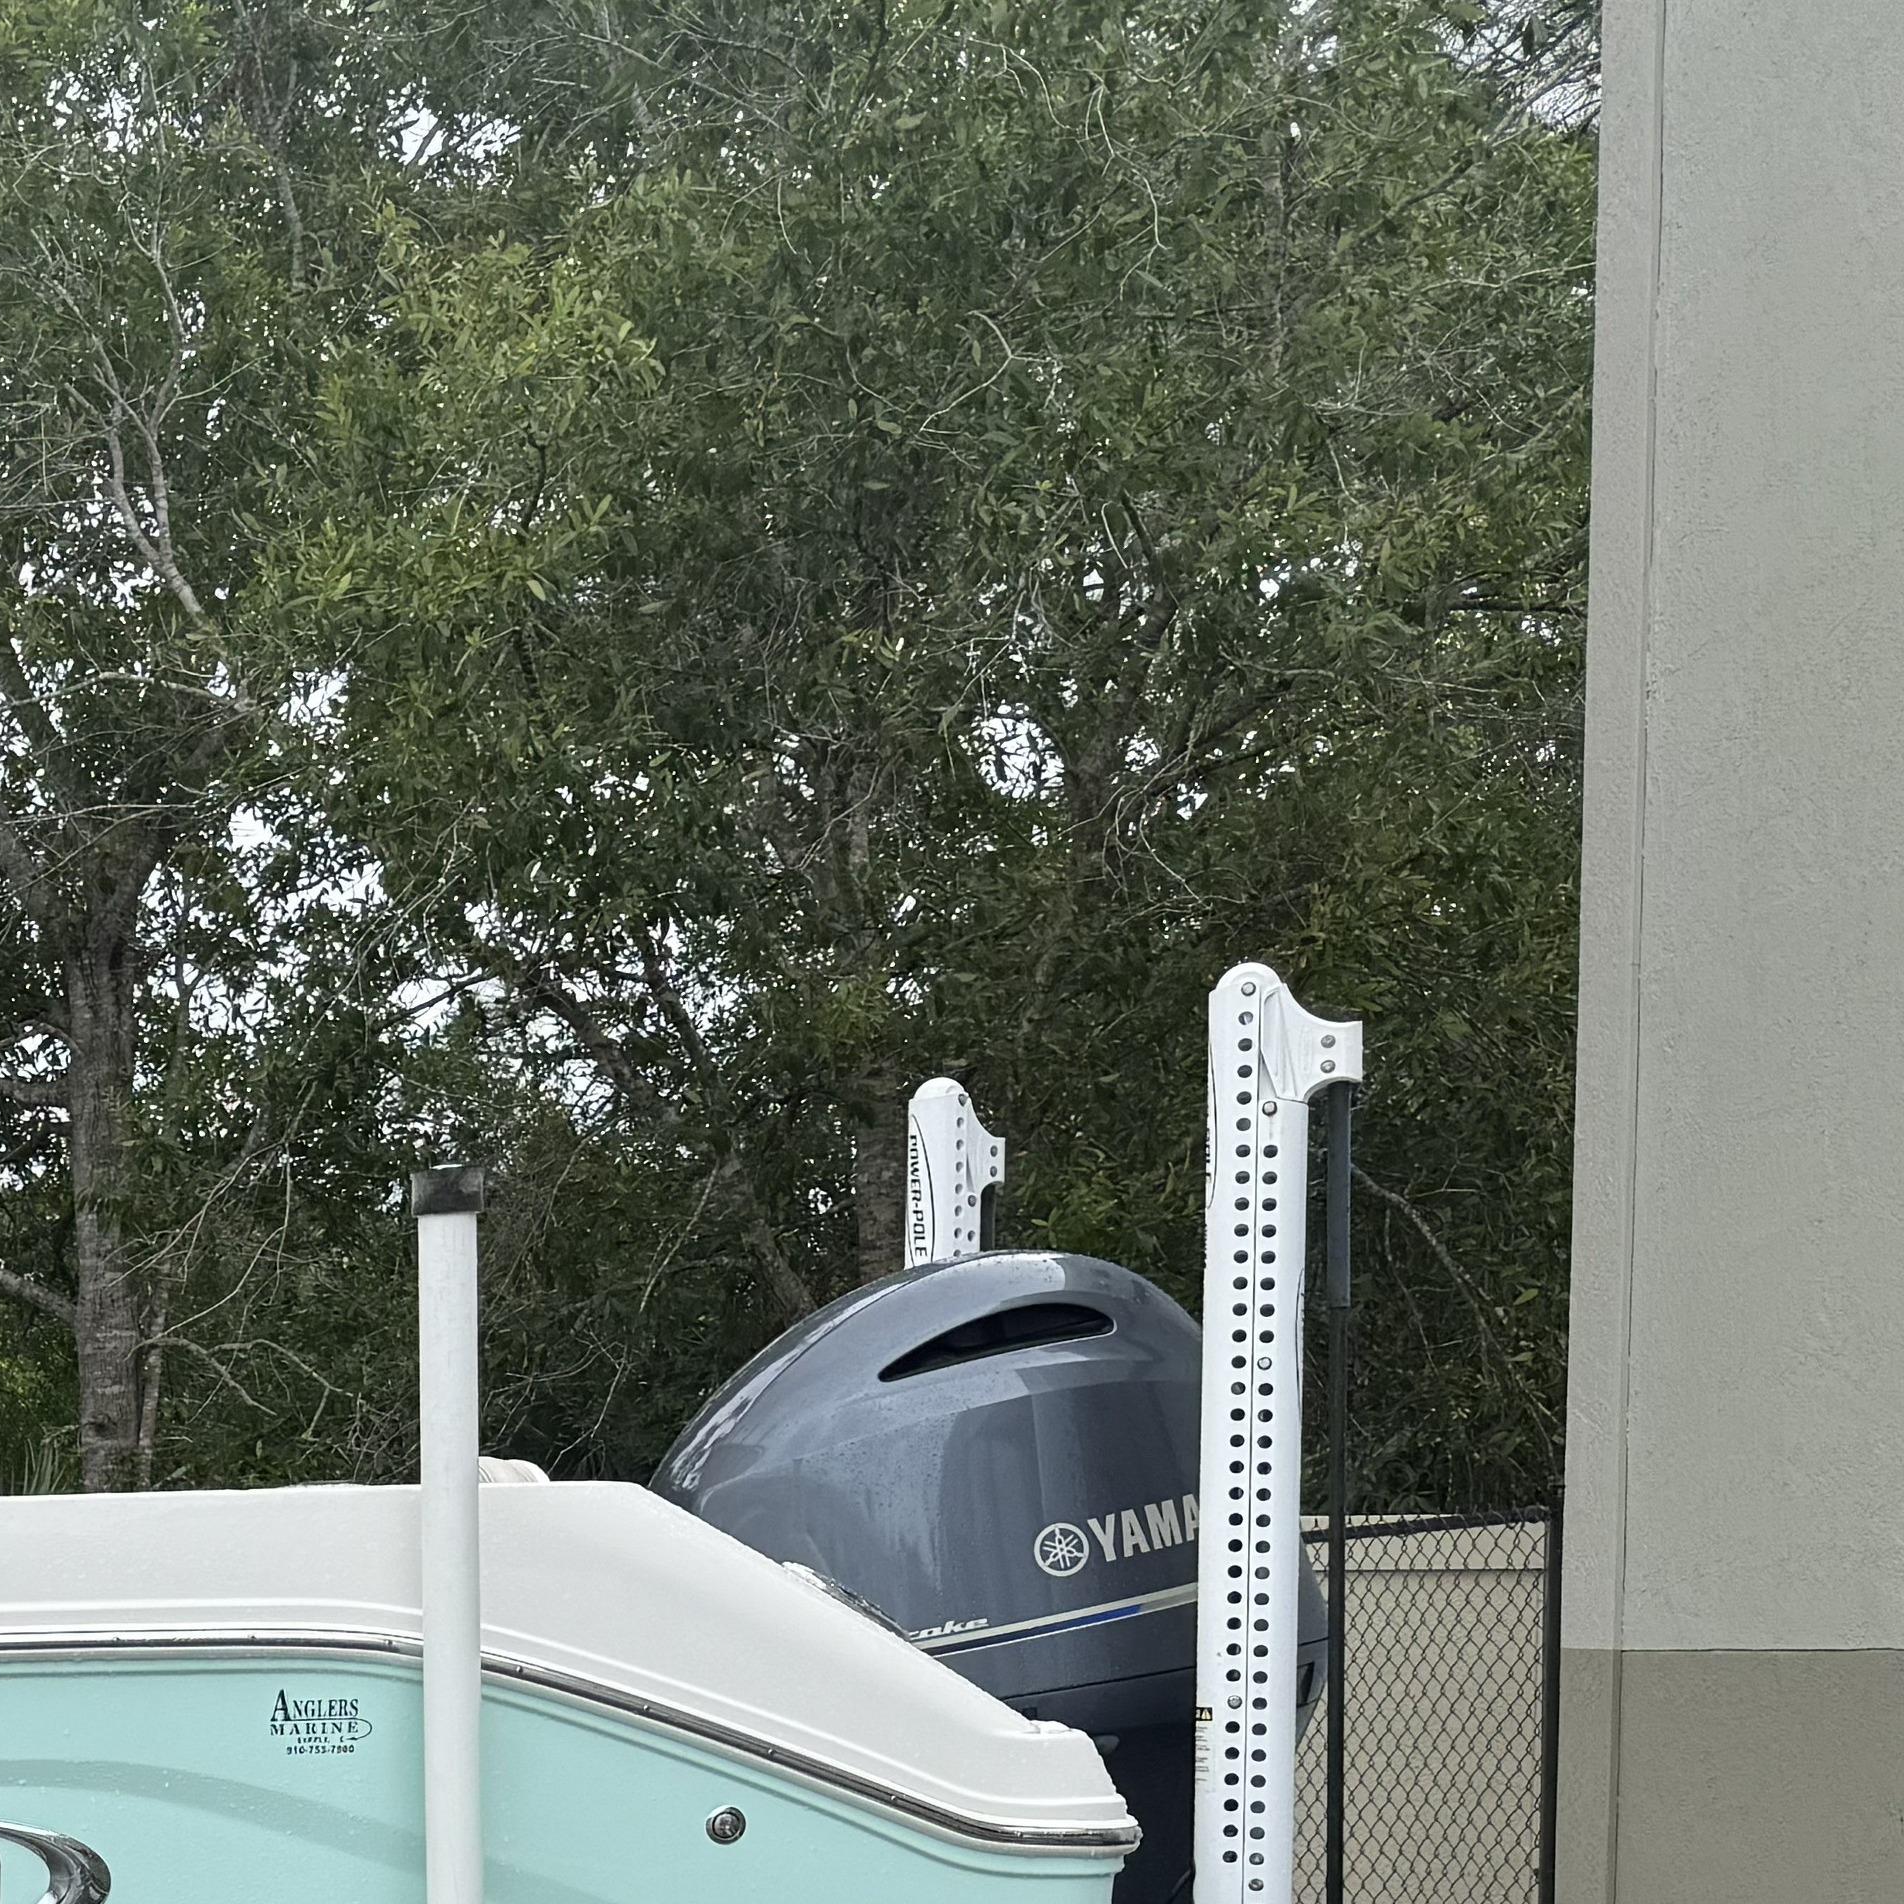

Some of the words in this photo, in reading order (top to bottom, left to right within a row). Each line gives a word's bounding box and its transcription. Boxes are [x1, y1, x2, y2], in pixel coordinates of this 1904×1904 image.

[909, 1133, 928, 1258] POWER-POLE
[1087, 1493, 1200, 1562] YAMA
[270, 1689, 359, 1721] ANGLERS
[270, 1721, 359, 1736] MARINE
